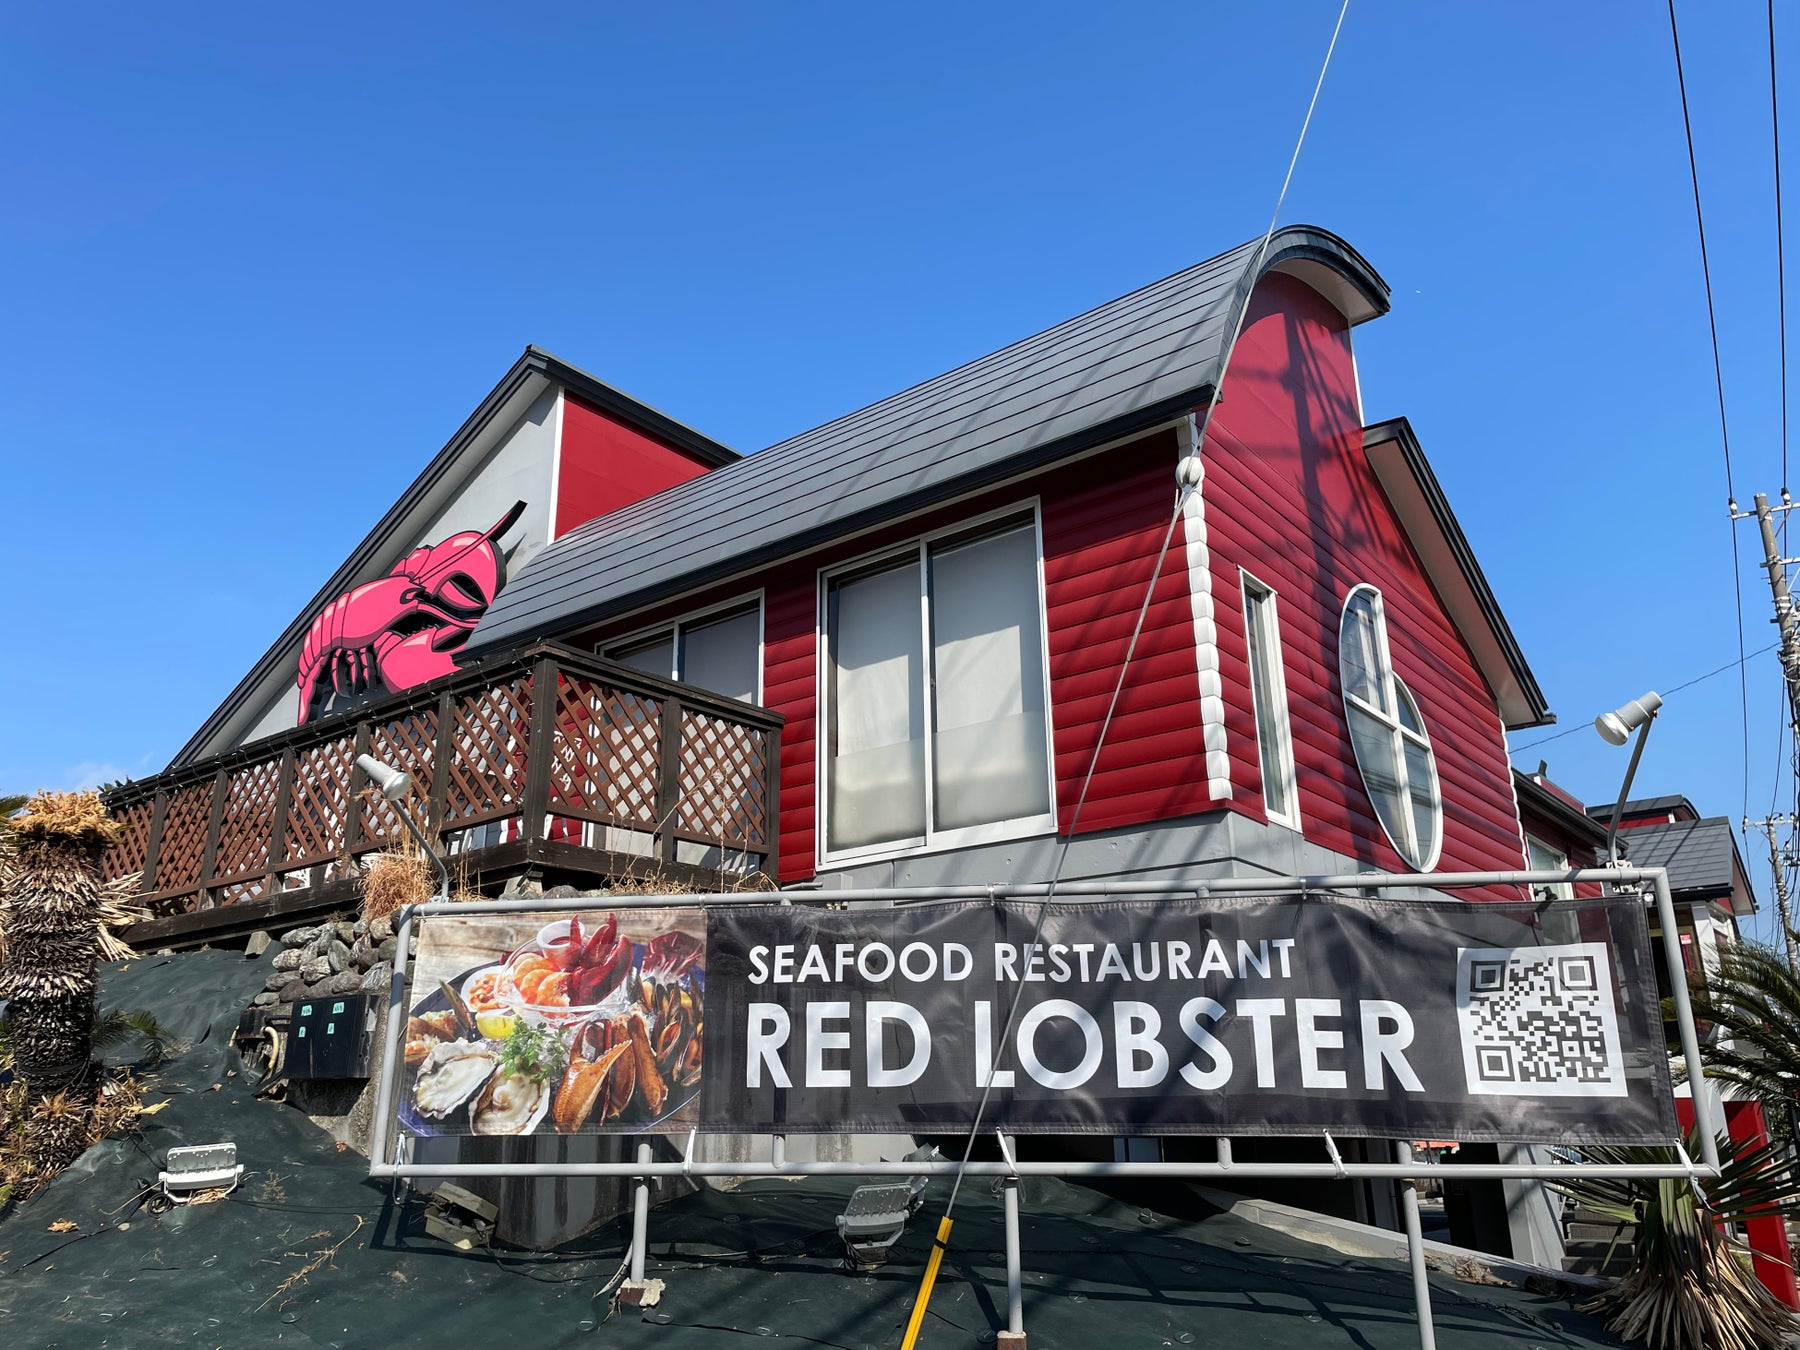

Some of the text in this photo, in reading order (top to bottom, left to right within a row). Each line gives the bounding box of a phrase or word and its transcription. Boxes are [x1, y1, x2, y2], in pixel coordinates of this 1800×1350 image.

[747, 938, 1295, 985] SEAFOOD RESTAURANT
[746, 997, 1426, 1092] RED LOBSTER
